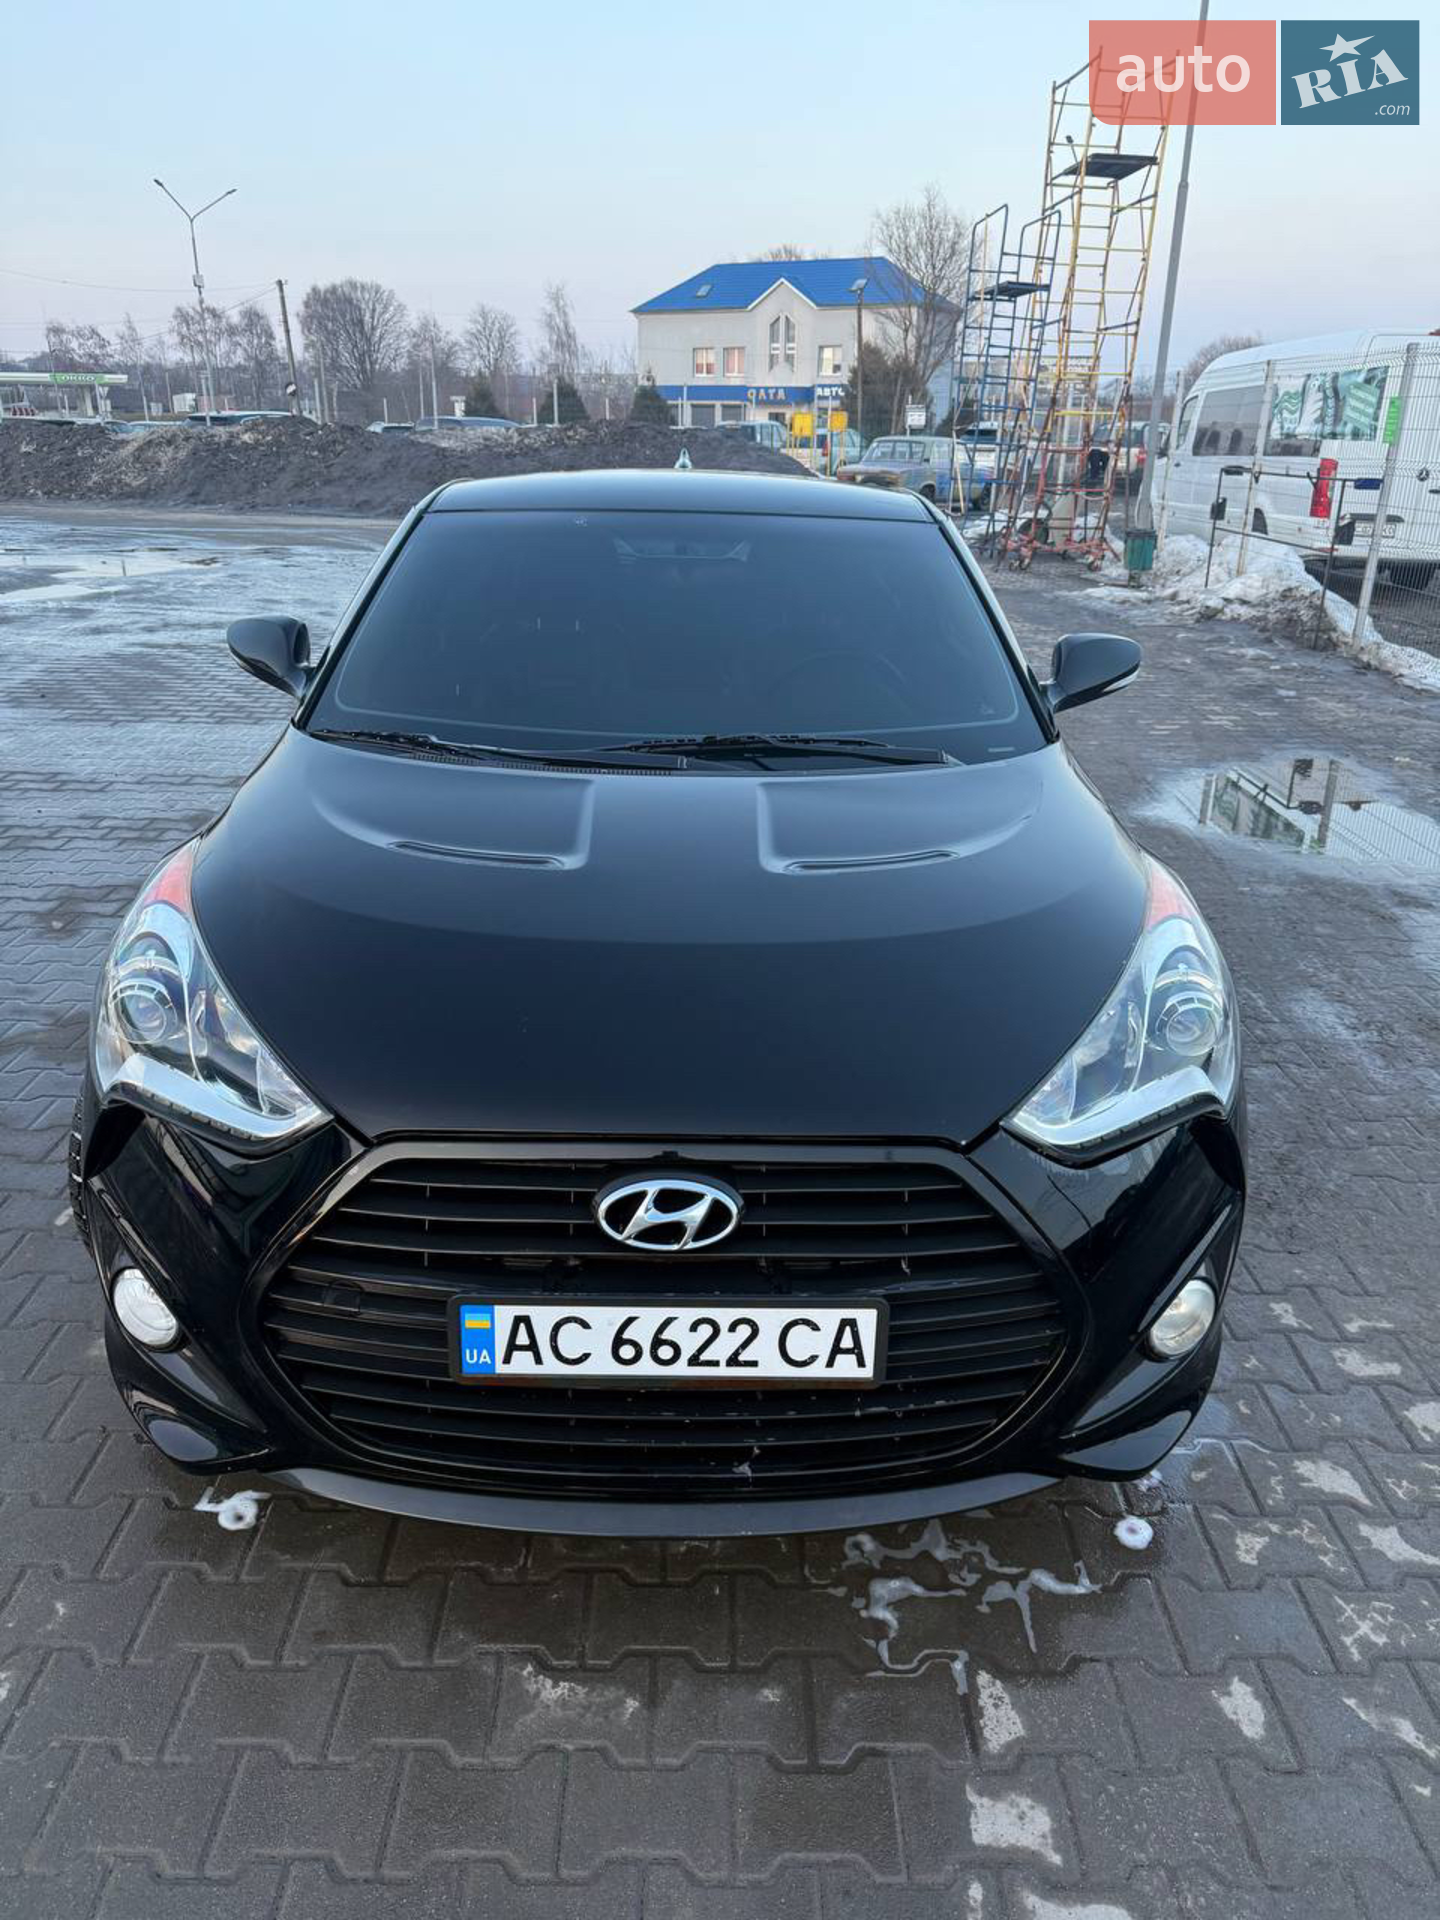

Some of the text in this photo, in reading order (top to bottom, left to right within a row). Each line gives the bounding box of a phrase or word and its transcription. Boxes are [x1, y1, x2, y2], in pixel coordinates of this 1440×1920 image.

[465, 1349, 492, 1365] UA
[502, 1314, 867, 1369] AC 6622 CA
